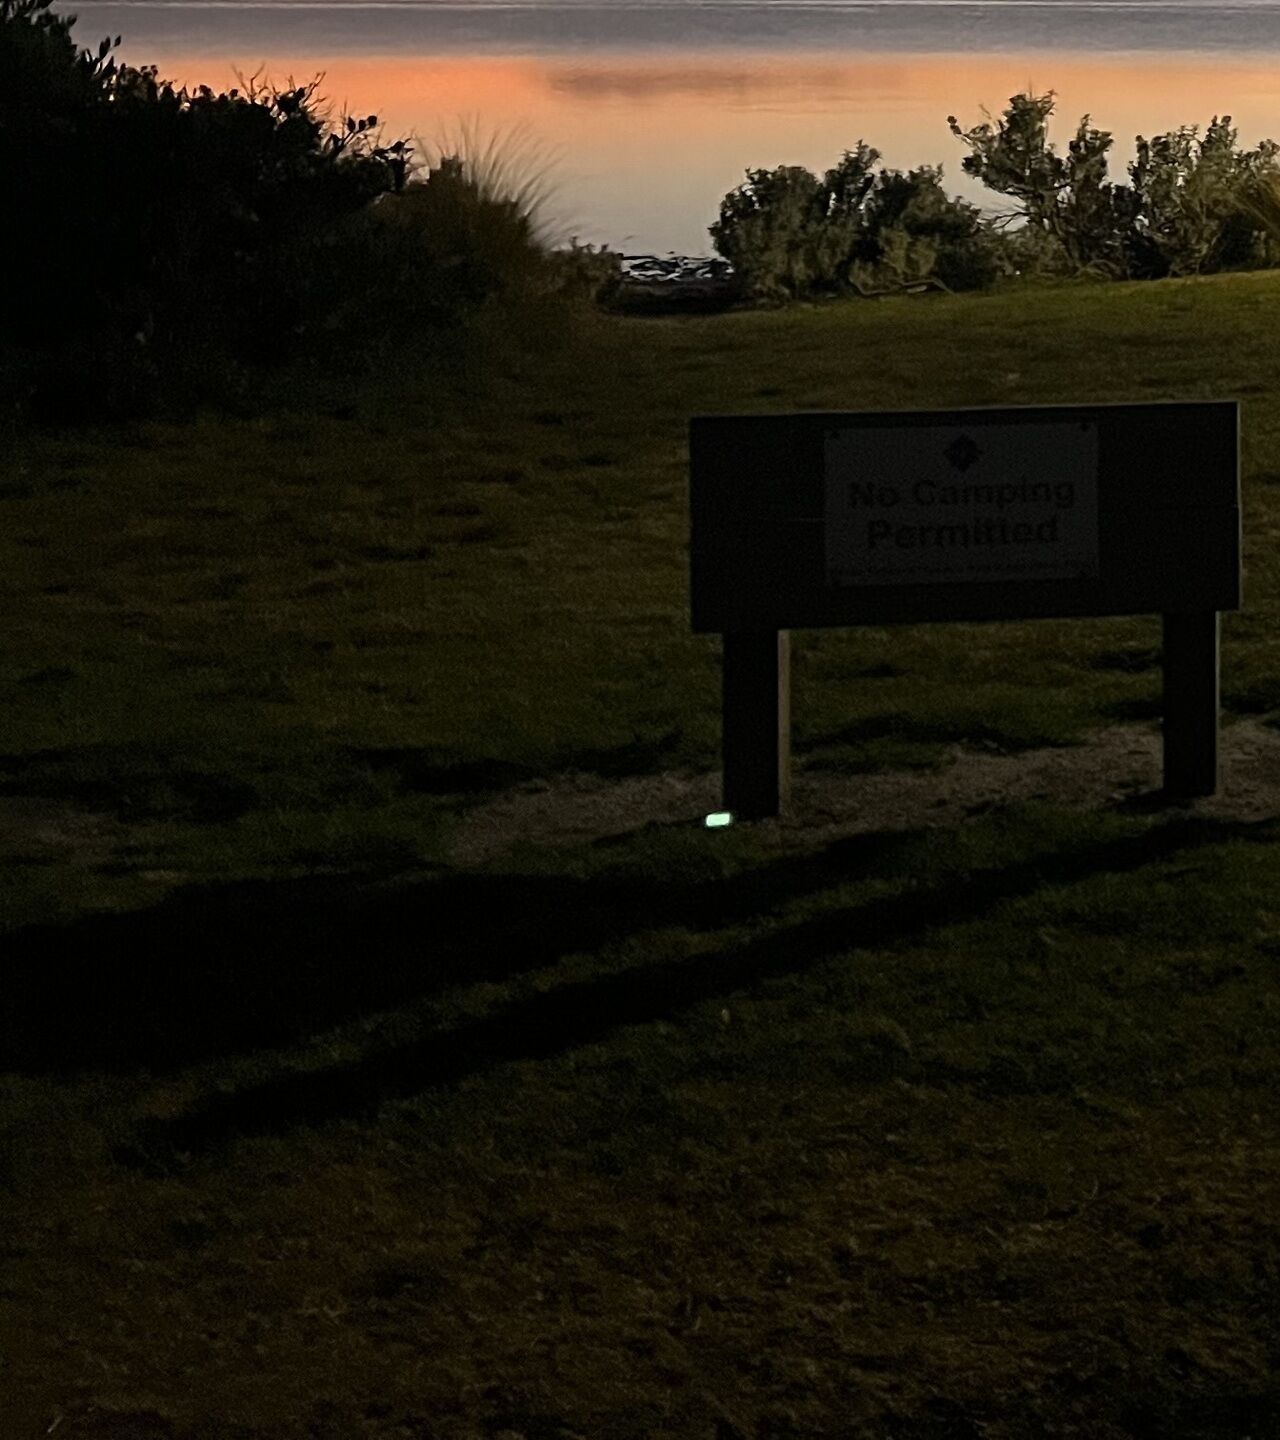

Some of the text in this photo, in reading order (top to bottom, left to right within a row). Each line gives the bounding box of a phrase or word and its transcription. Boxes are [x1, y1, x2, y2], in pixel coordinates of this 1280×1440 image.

[848, 479, 1075, 509] No Camping
[867, 517, 1058, 549] Permitted
